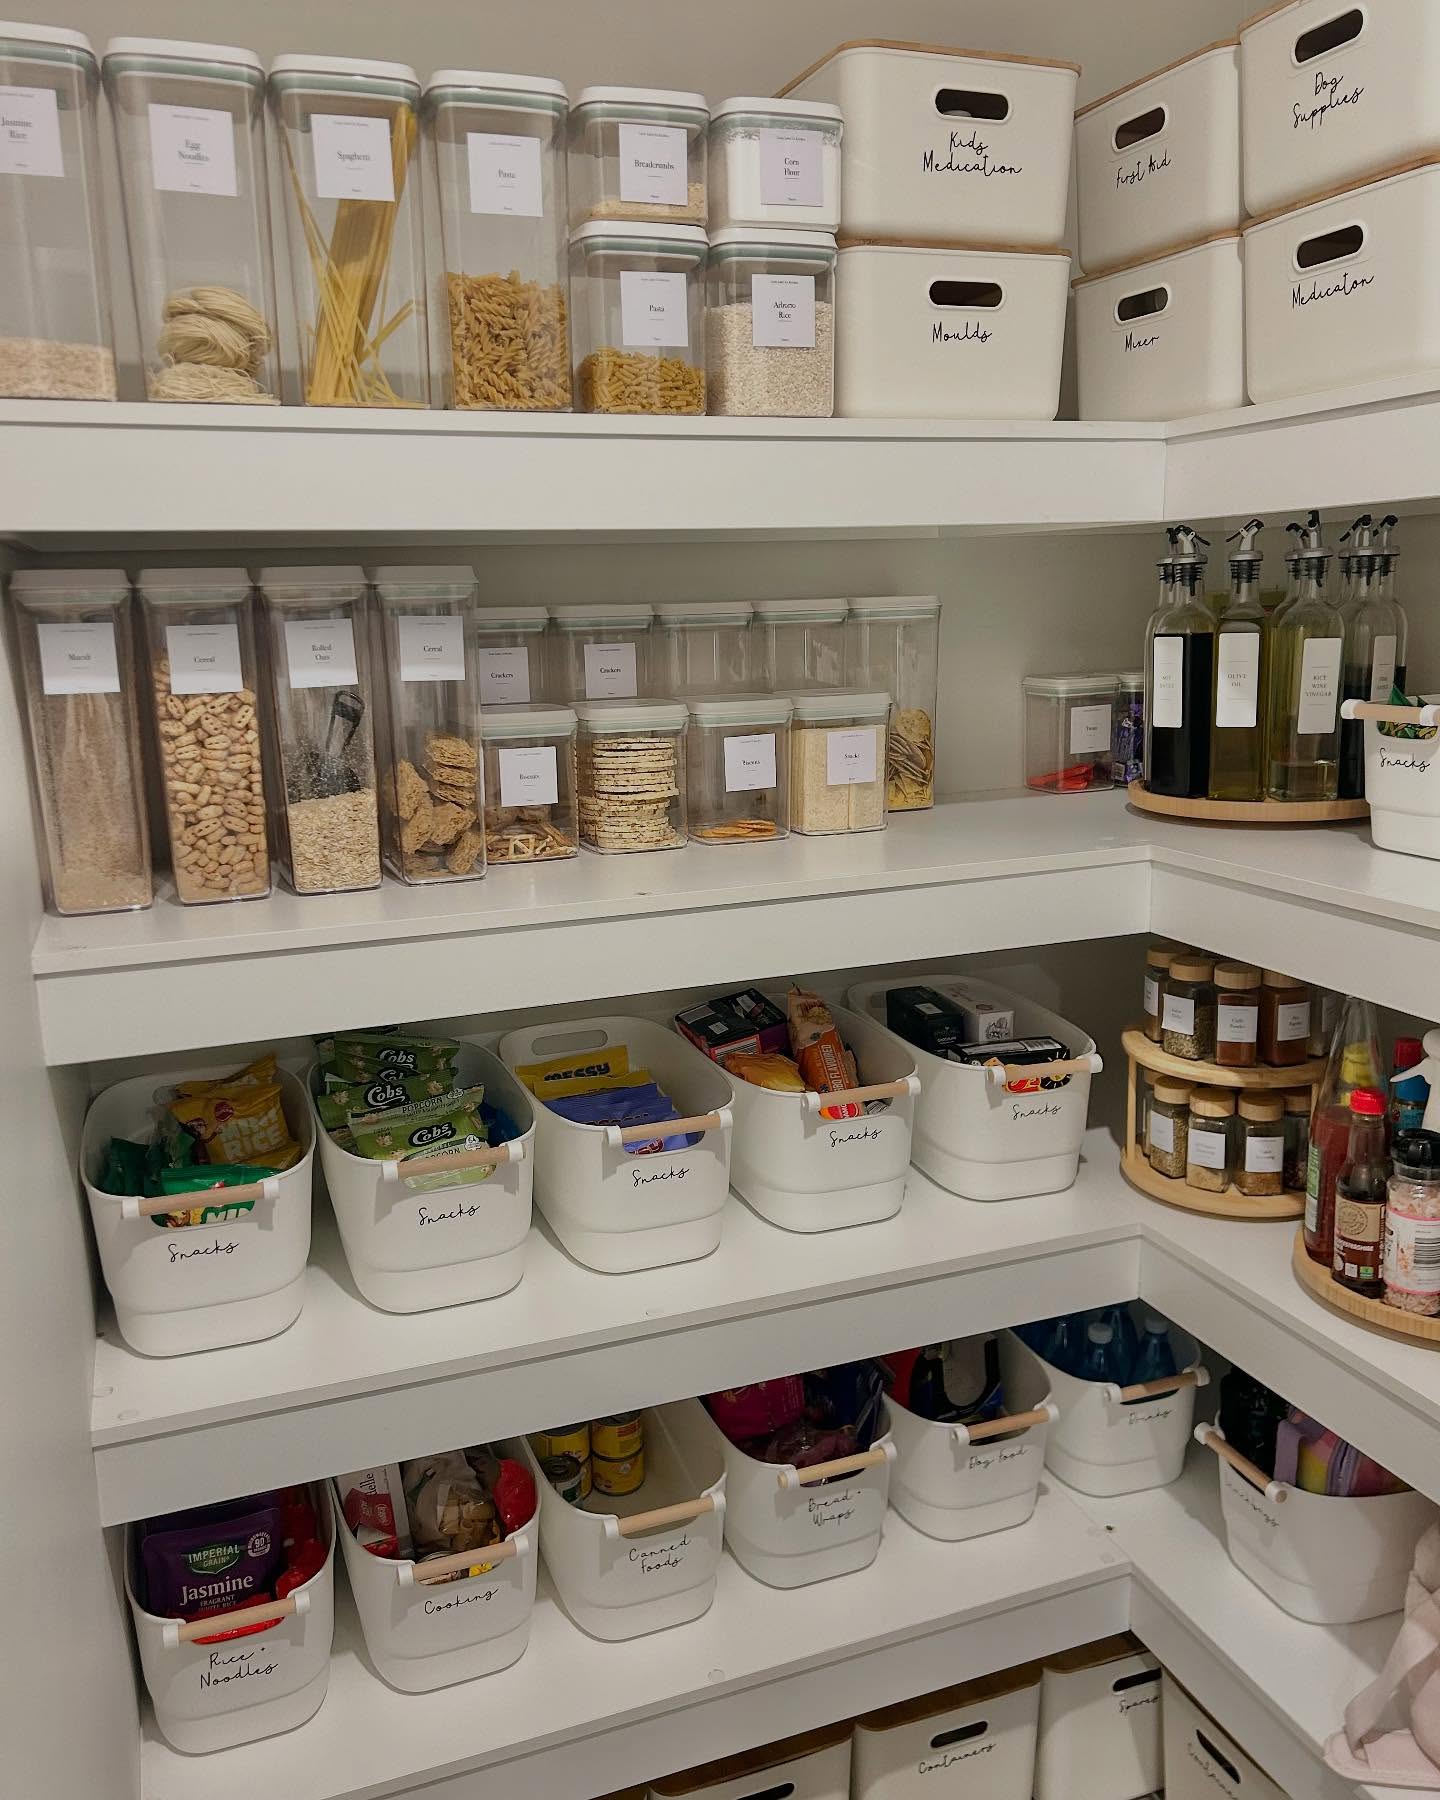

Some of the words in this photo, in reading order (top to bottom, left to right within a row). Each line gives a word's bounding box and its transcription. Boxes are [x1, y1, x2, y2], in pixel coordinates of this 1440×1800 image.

[1315, 72, 1344, 96] Dog
[1292, 88, 1364, 129] Supplies
[949, 131, 989, 155] Kids
[634, 159, 675, 170] Breadcrumbs
[784, 167, 800, 176] Flour
[923, 150, 1023, 176] Medication
[1116, 161, 1145, 189] First
[1148, 150, 1171, 174] Aid
[932, 322, 993, 343] Moulds
[1125, 332, 1160, 352] Mixer
[1380, 747, 1431, 773] Snacks
[367, 1085, 406, 1107] Cobs
[1012, 1103, 1062, 1121] Snacks
[411, 1122, 453, 1145] Cobs
[829, 1126, 883, 1147] Snacks
[632, 1166, 690, 1188] Snacks
[418, 1203, 481, 1226] Snacks
[167, 1239, 240, 1263] Snacks
[808, 1490, 850, 1513] Bread
[188, 1544, 241, 1563] IMPERIAL
[629, 1536, 692, 1562] Canned
[180, 1574, 255, 1606] Jasmine
[200, 1594, 236, 1607] FRAGRANT
[424, 1583, 499, 1615] Cooking
[209, 1651, 256, 1670] Rice
[200, 1662, 280, 1690] Noodles
[918, 1743, 997, 1774] Containers
